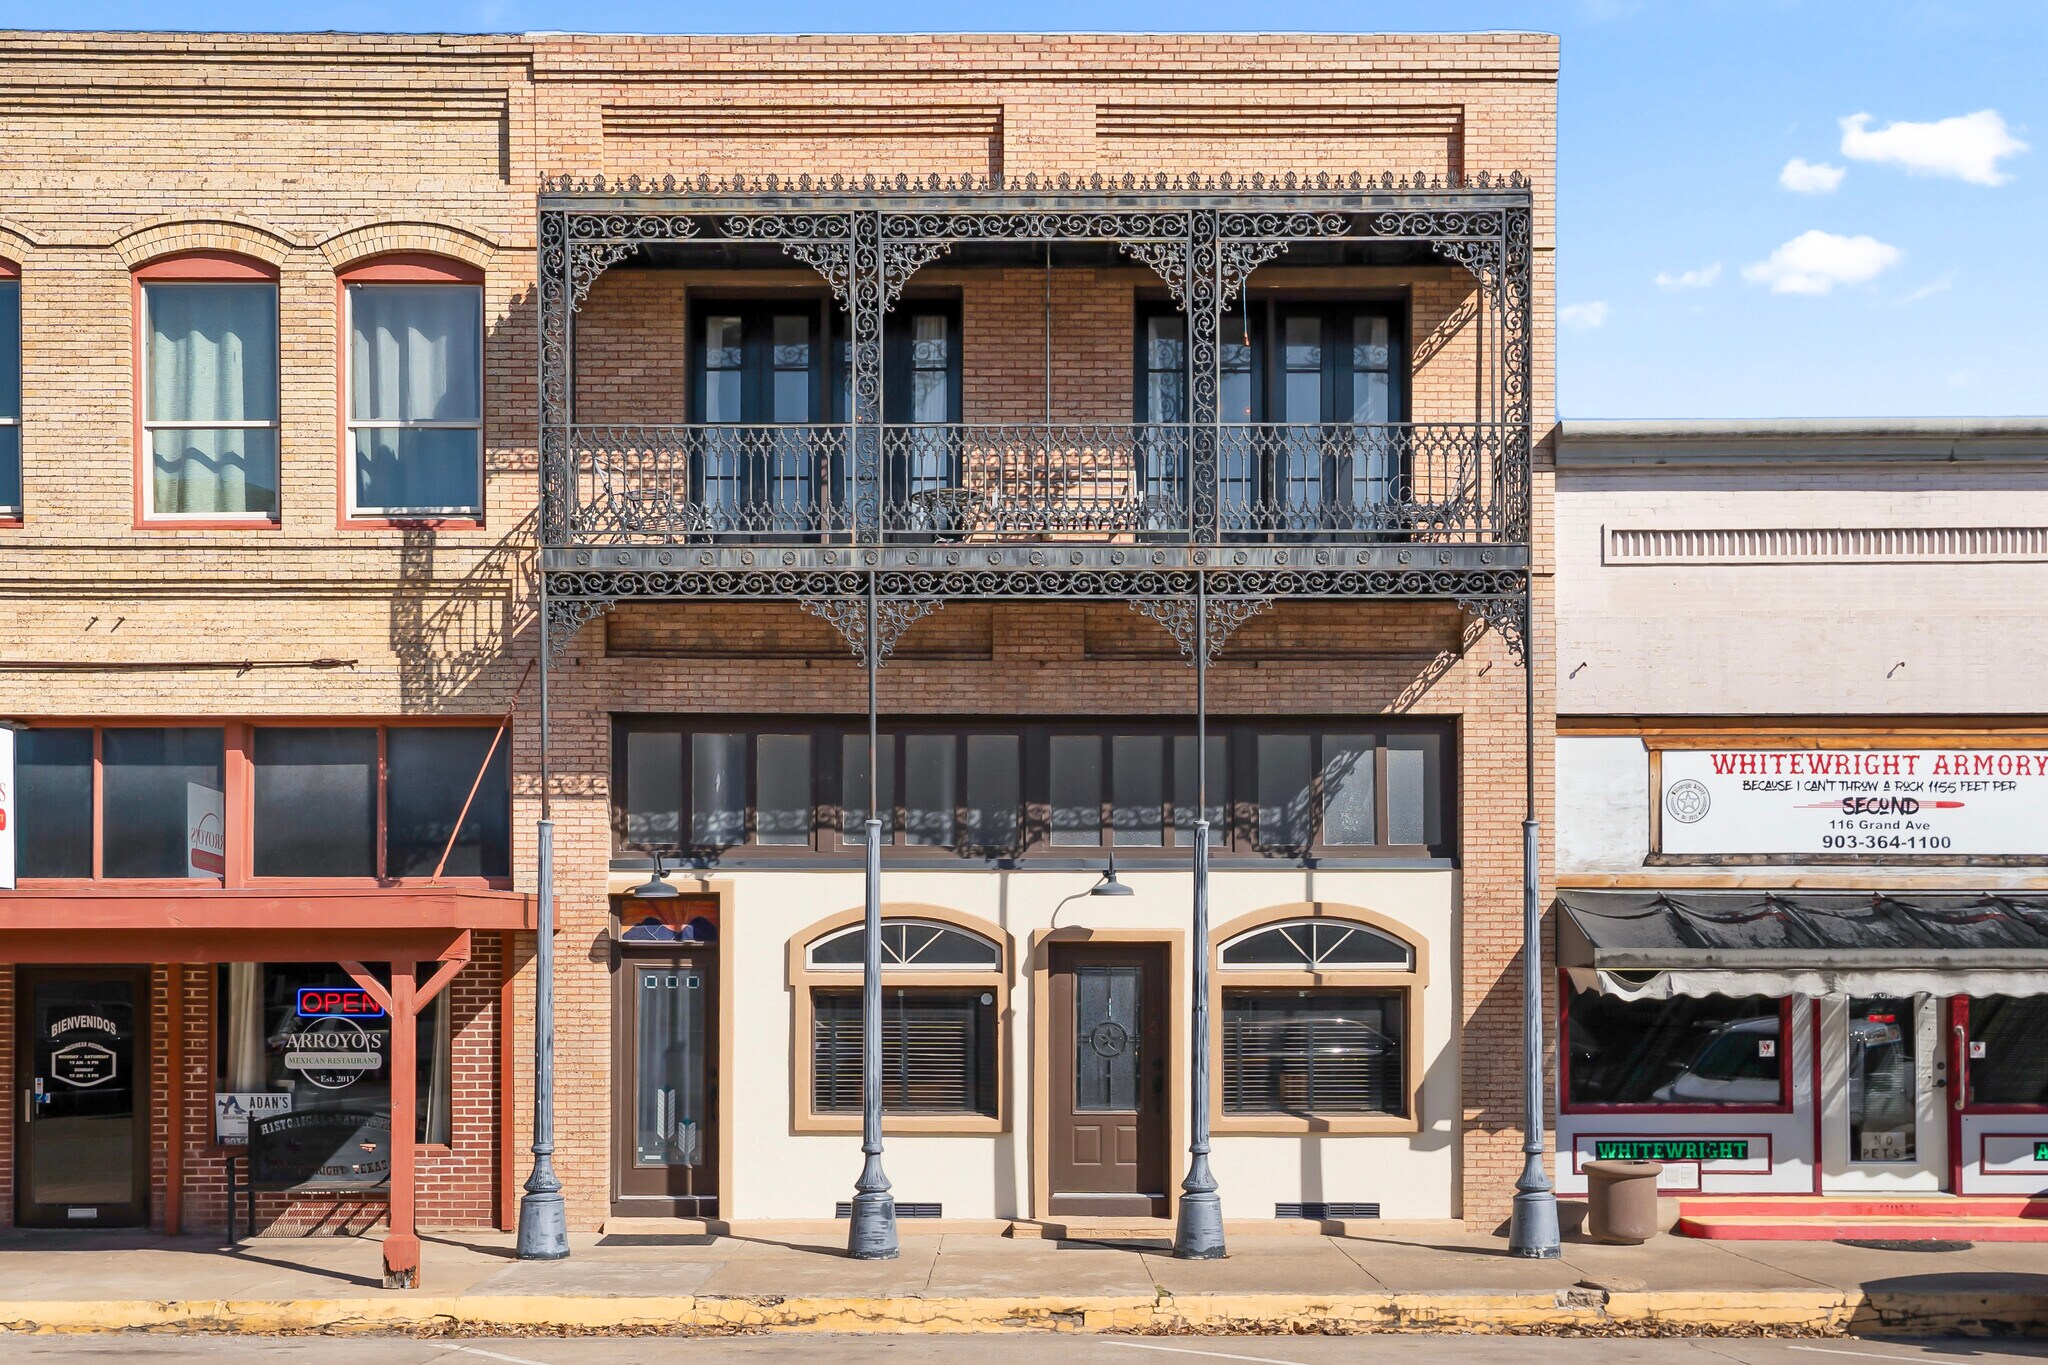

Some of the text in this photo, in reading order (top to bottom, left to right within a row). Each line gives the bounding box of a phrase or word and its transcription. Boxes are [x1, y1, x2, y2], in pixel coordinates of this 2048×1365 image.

[1711, 753, 2048, 776] WHITEWRIGHT ARMORY
[1742, 779, 2017, 793] BECAUSE I CAN'T THROW A ROCK 1155 FEET PER
[1842, 796, 1920, 815] SECOND
[1829, 820, 1931, 830] 116 Grand Ave
[1822, 835, 1951, 849] 903-364-1100
[302, 992, 380, 1012] OPEN
[51, 1015, 117, 1038] BIENVENIDOS
[285, 1033, 382, 1049] ARROYO'S
[288, 1057, 379, 1065] MEXICAN RESTAURANT
[320, 1075, 335, 1083] Est.
[249, 1096, 289, 1109] ADAN'S
[1597, 1142, 1747, 1159] WHITEWRIGHT
[1862, 1148, 1900, 1159] PETS
[352, 1159, 389, 1175] TEXAS
